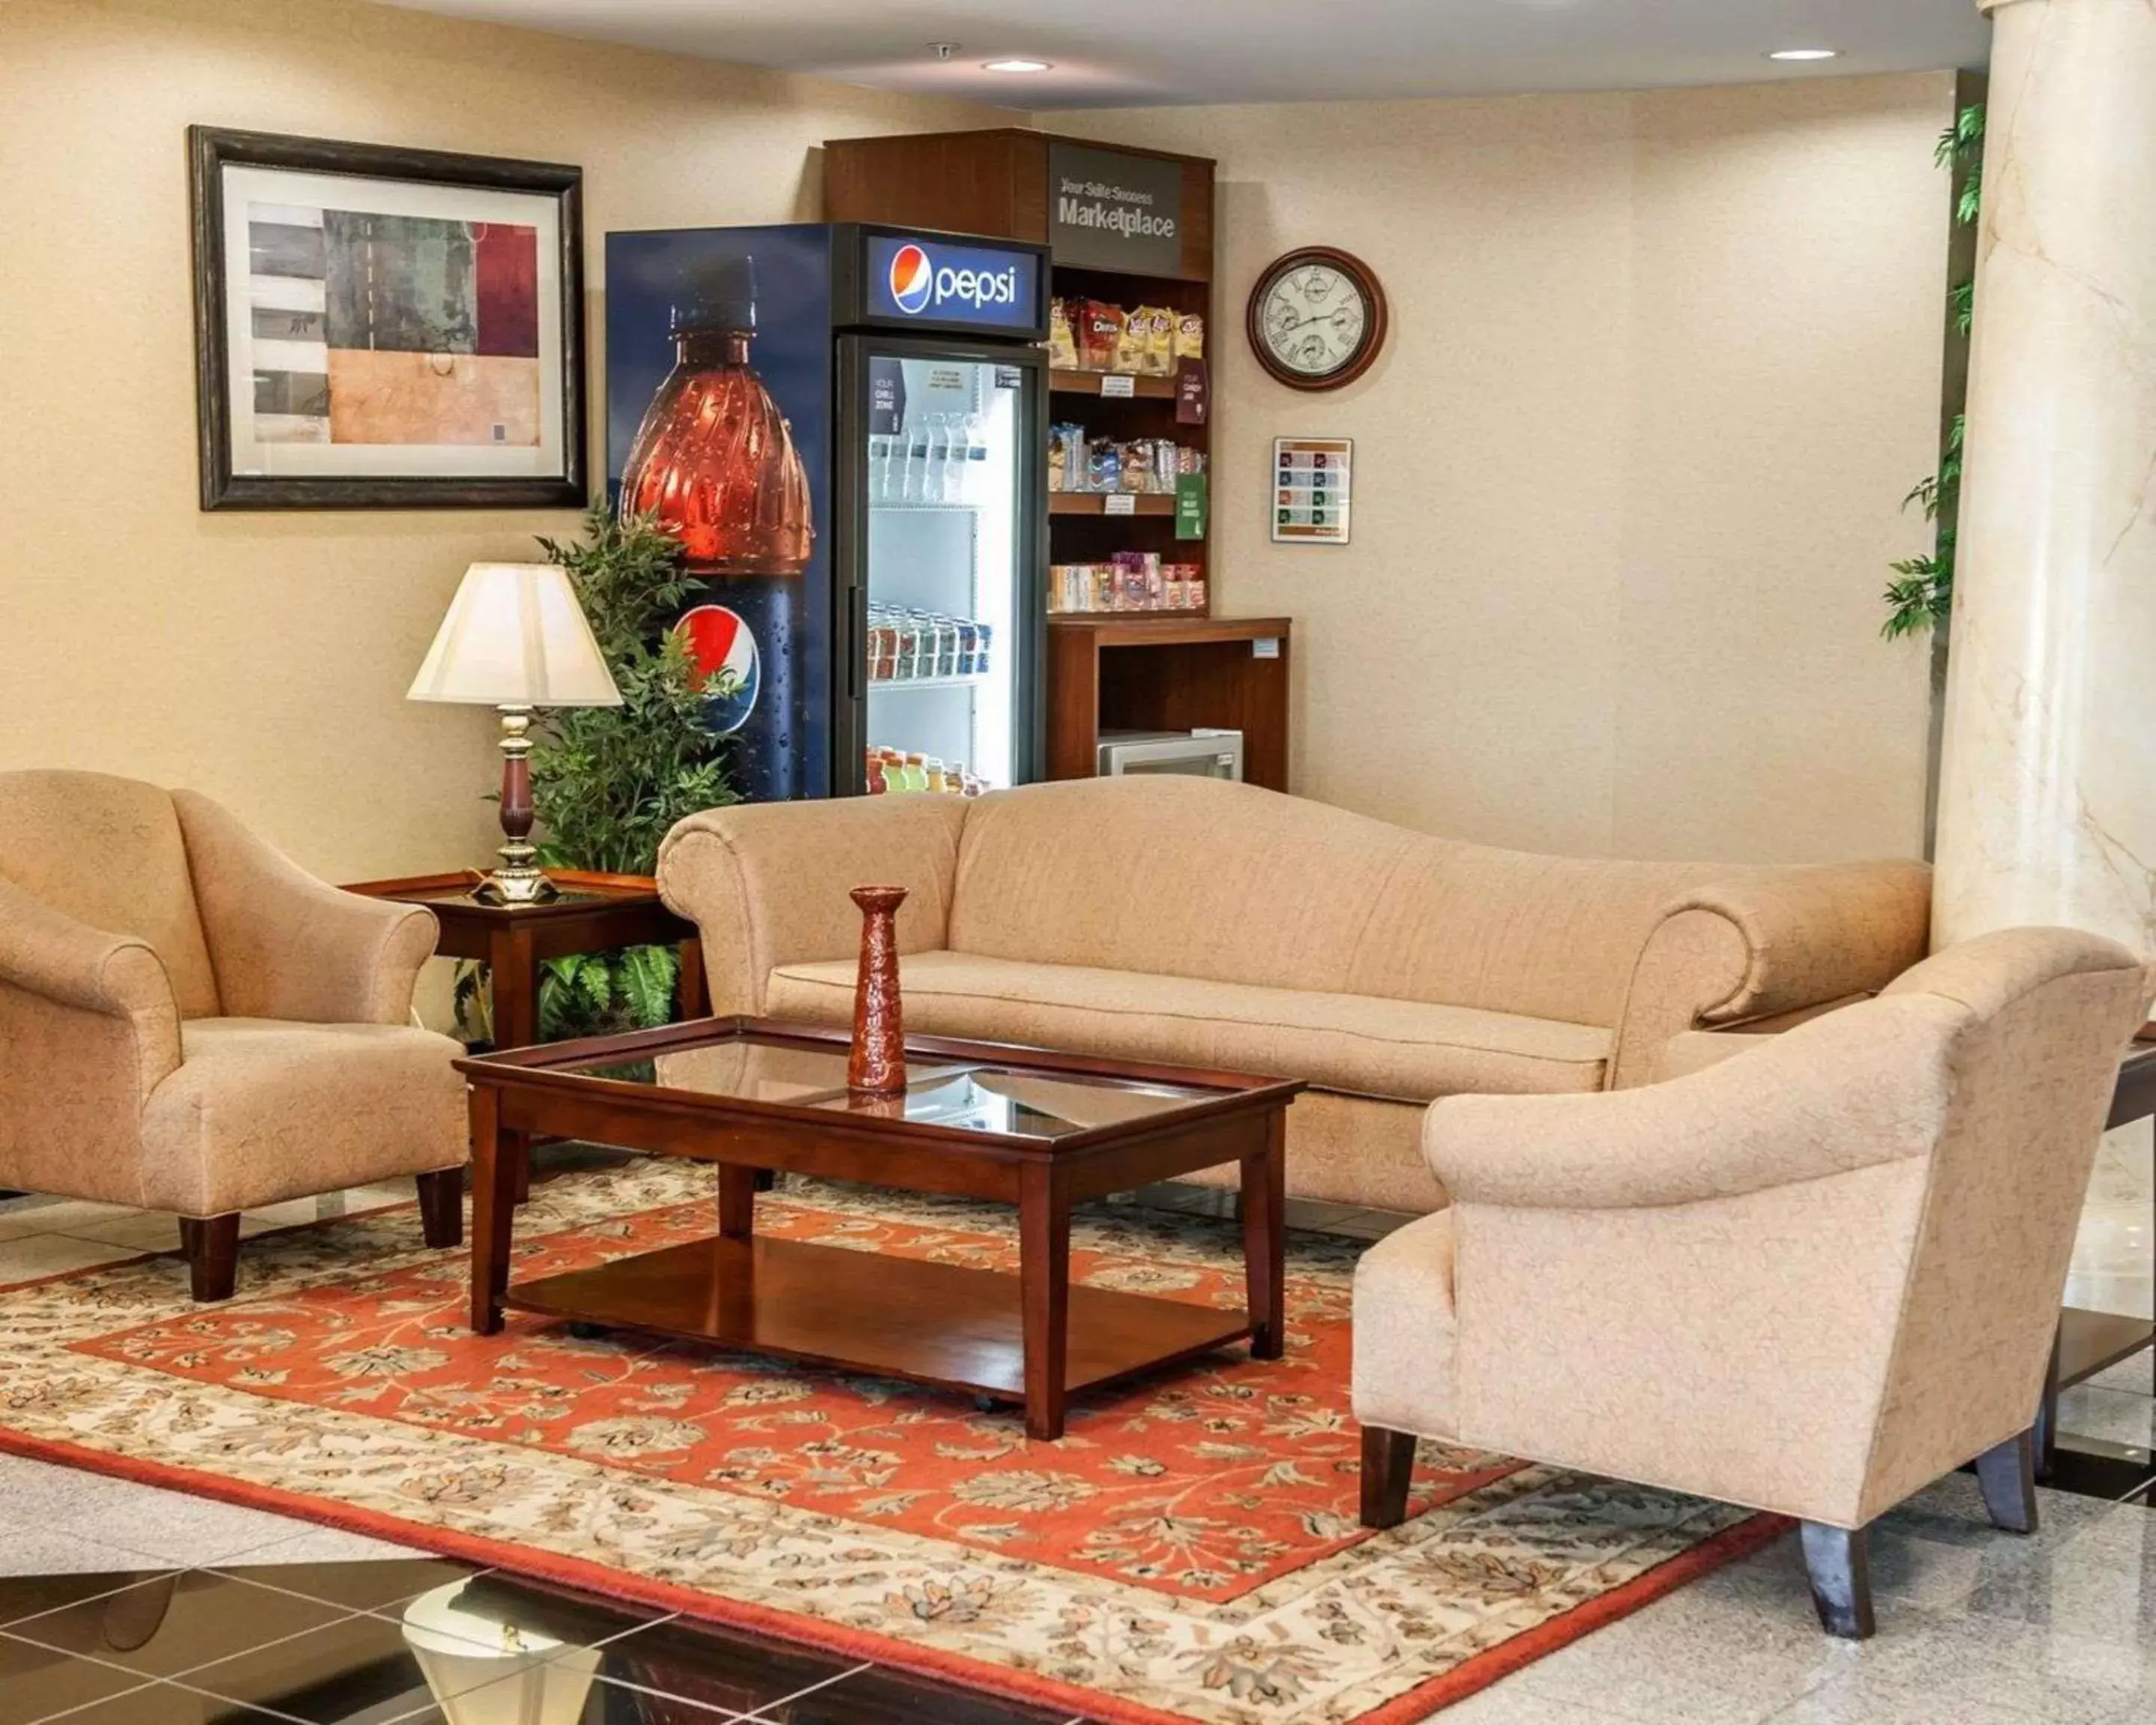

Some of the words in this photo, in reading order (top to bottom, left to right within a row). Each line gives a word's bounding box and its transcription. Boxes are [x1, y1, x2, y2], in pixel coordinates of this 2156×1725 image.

[1061, 177, 1084, 195] Your
[1085, 182, 1111, 199] Suite
[1112, 186, 1154, 206] Success
[1059, 196, 1175, 238] Marketplace
[935, 266, 1014, 308] pepsi
